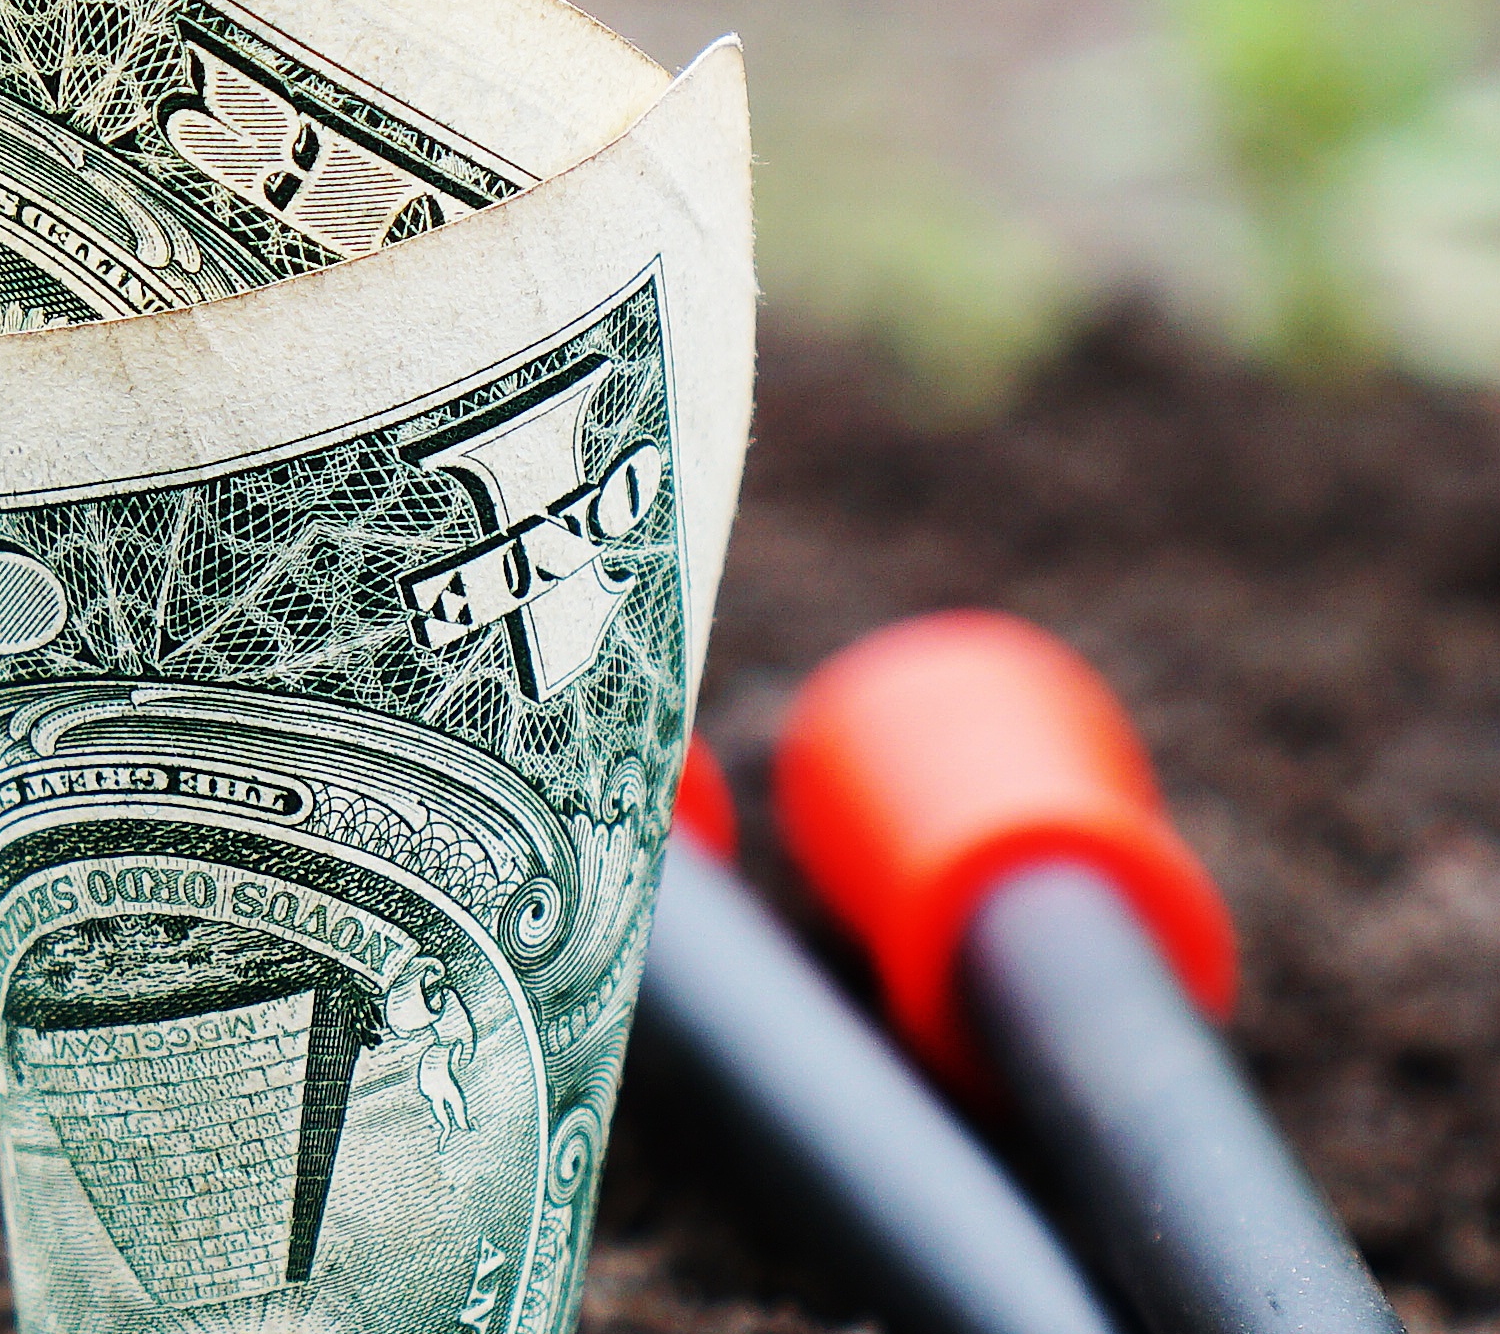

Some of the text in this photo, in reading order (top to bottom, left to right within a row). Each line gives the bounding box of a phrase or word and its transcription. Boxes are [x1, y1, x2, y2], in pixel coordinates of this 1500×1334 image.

[400, 440, 662, 648] ONE
[21, 766, 169, 796] GREAT
[177, 770, 286, 812] THE
[89, 865, 216, 907] ORDO
[232, 880, 397, 972] NOVUS
[49, 1013, 256, 1061] MDCCLXXVI
